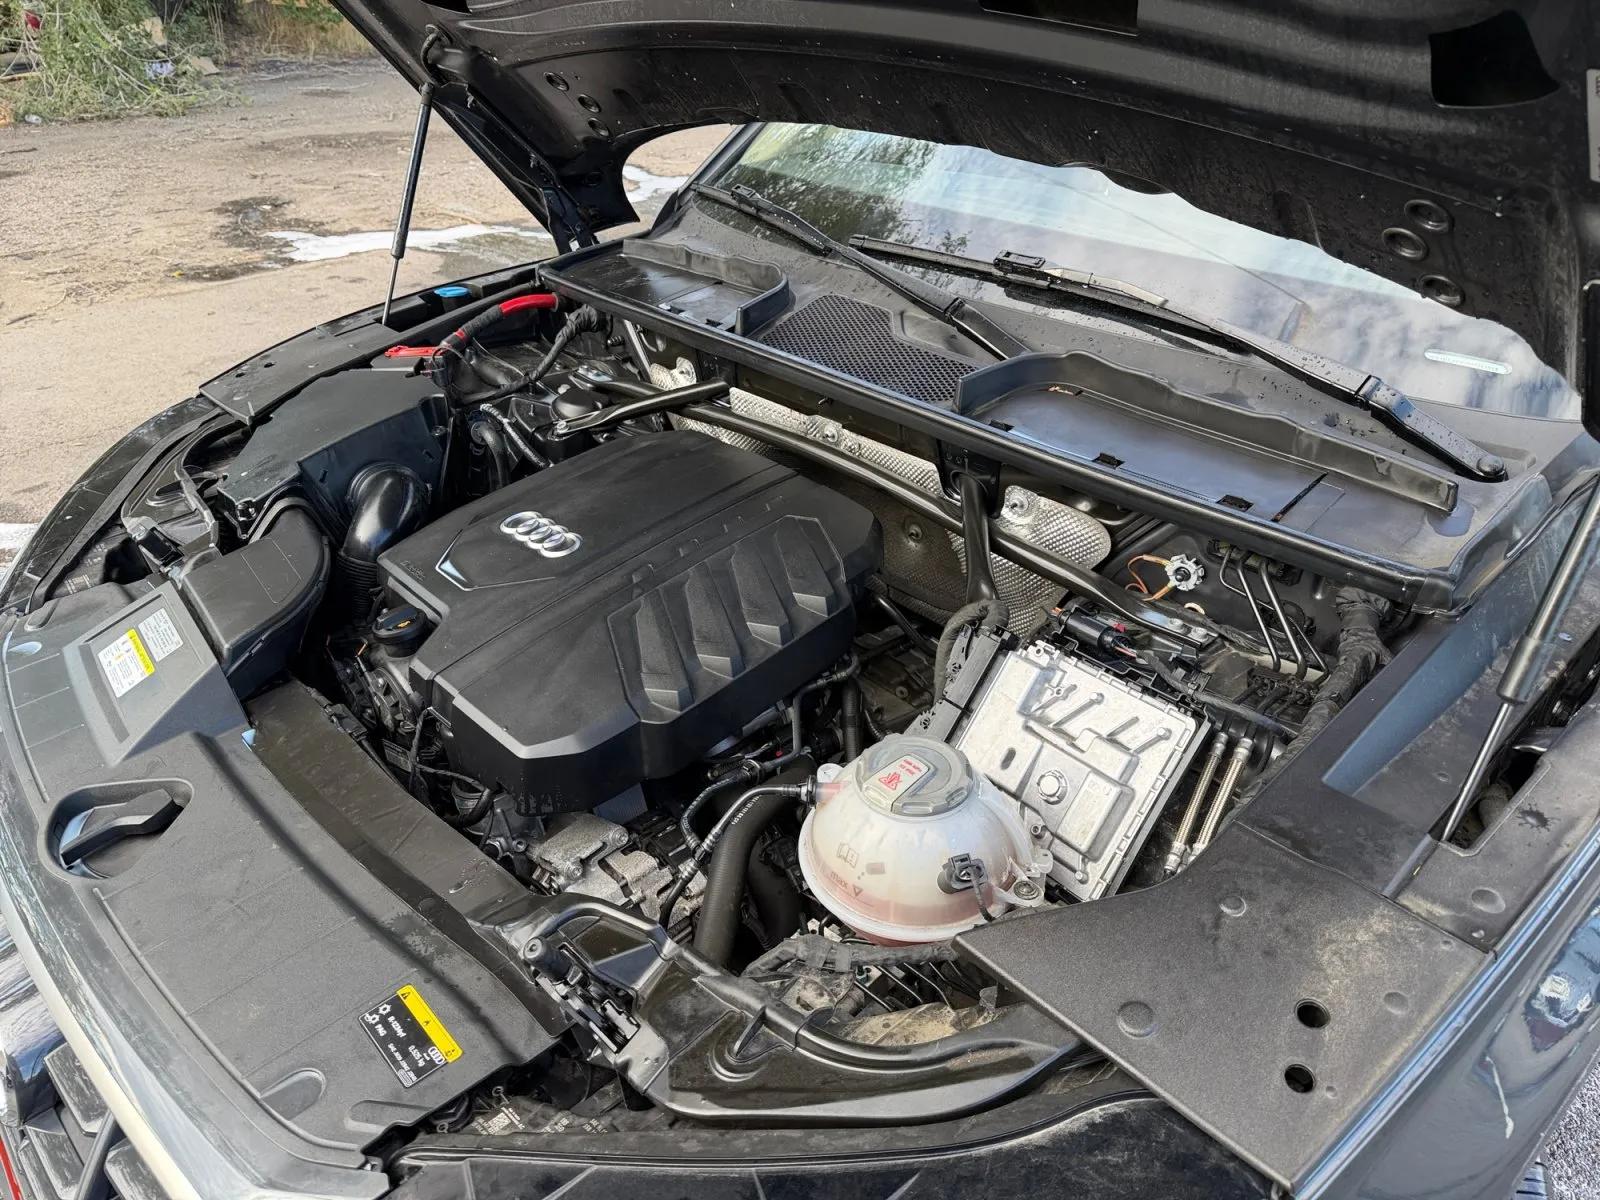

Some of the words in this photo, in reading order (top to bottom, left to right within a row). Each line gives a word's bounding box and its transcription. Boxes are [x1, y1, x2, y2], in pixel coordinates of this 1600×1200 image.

[830, 872, 849, 889] max
[375, 1024, 387, 1037] PAG
[388, 1016, 407, 1038] R-1234yf
